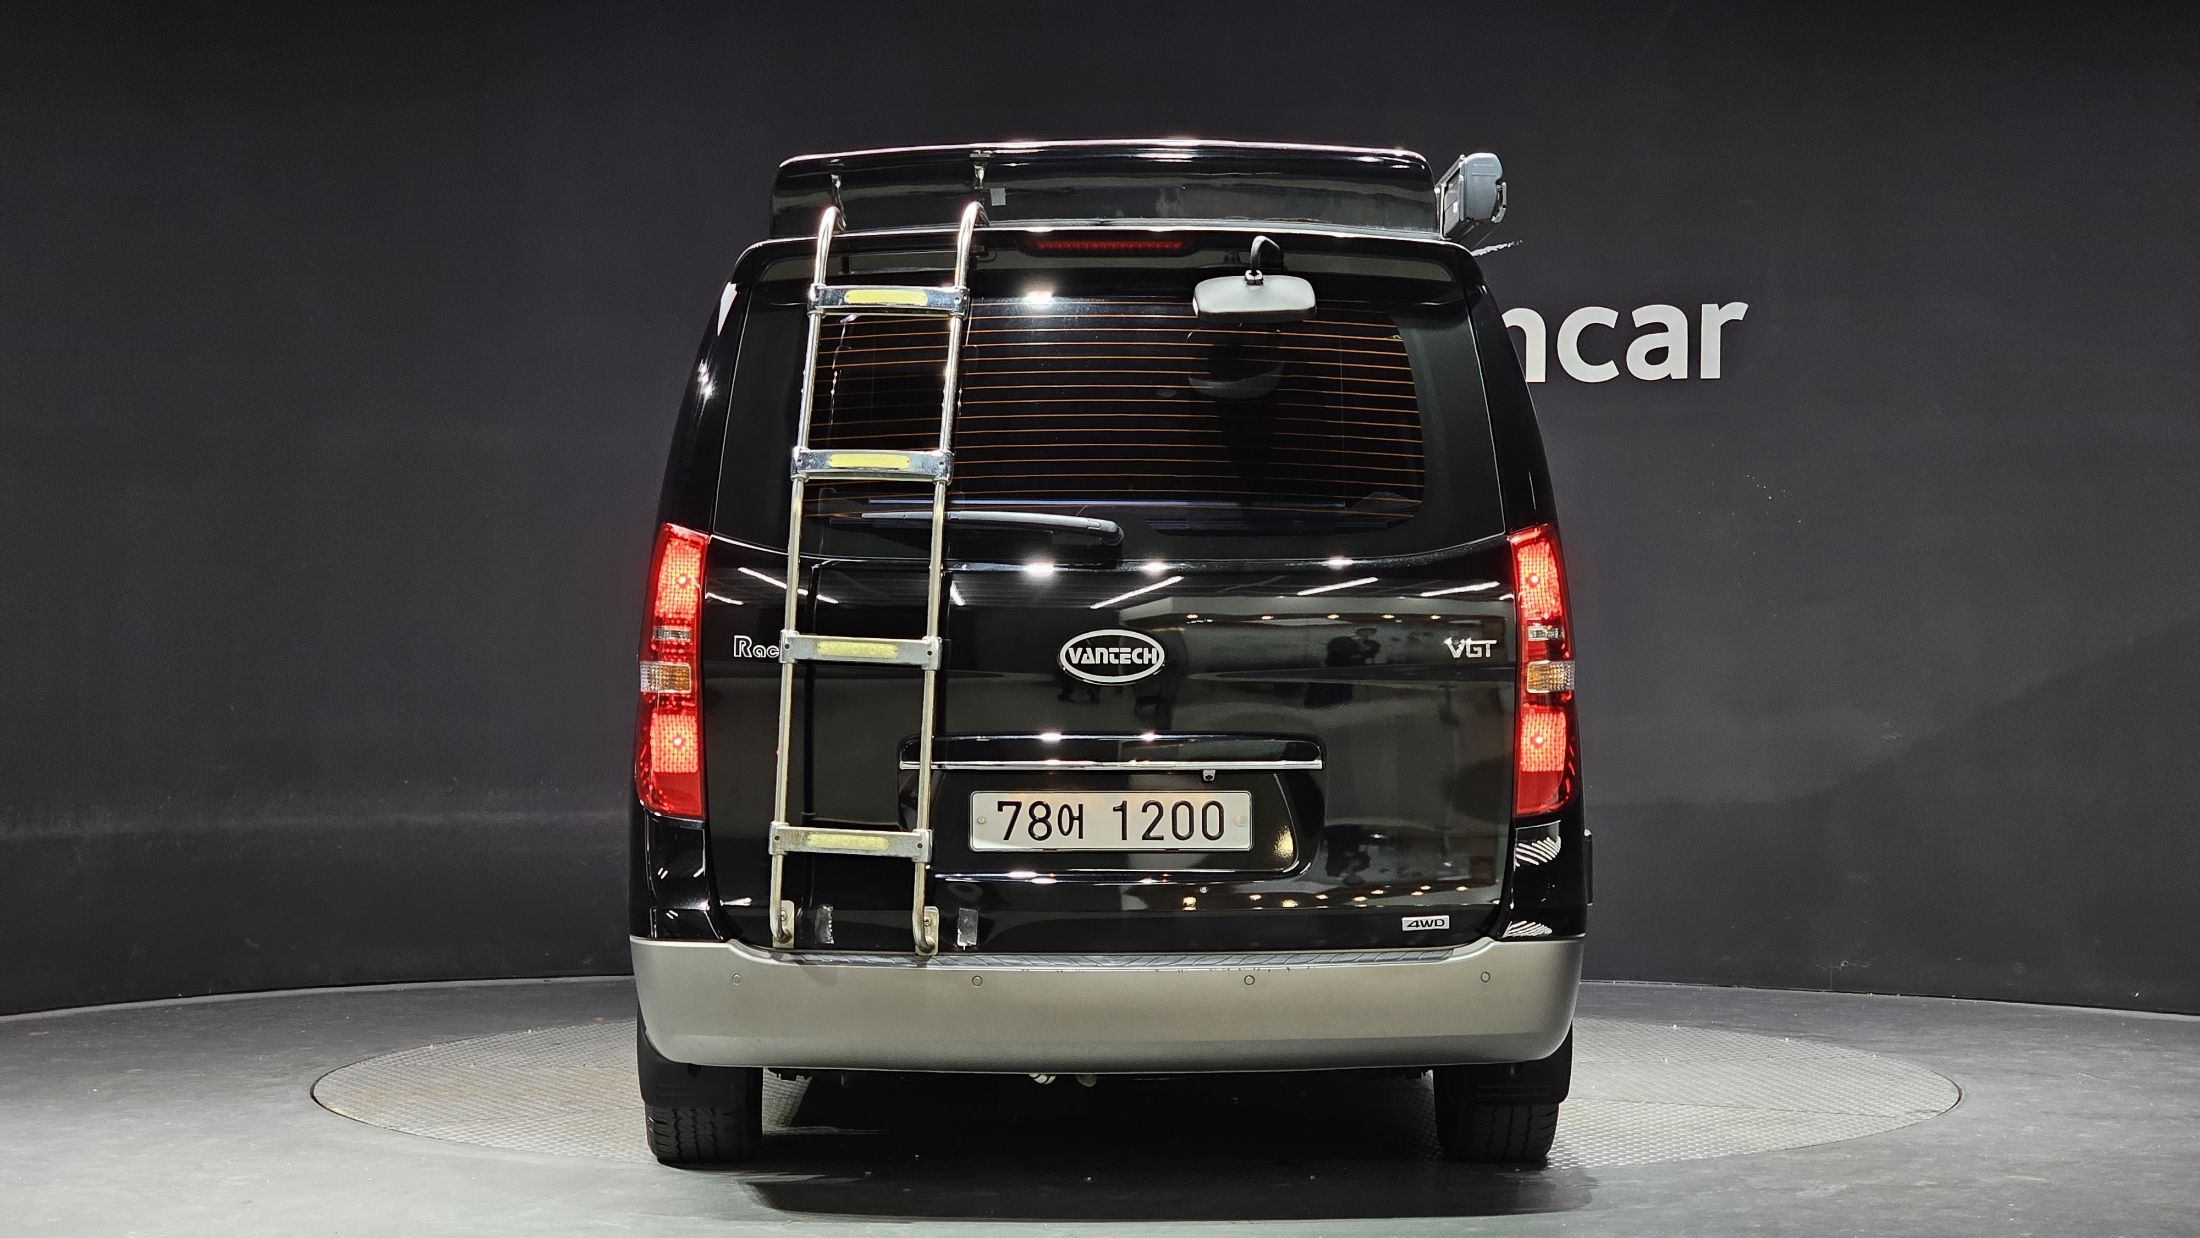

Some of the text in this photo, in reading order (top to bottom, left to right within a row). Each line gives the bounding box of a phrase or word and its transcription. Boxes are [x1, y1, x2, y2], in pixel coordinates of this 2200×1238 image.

[733, 635, 780, 658] Rac
[1068, 647, 1158, 665] VANTECH
[1443, 637, 1498, 659] VGT
[997, 800, 1225, 841] 78어 1200
[1406, 918, 1446, 929] 4WD
